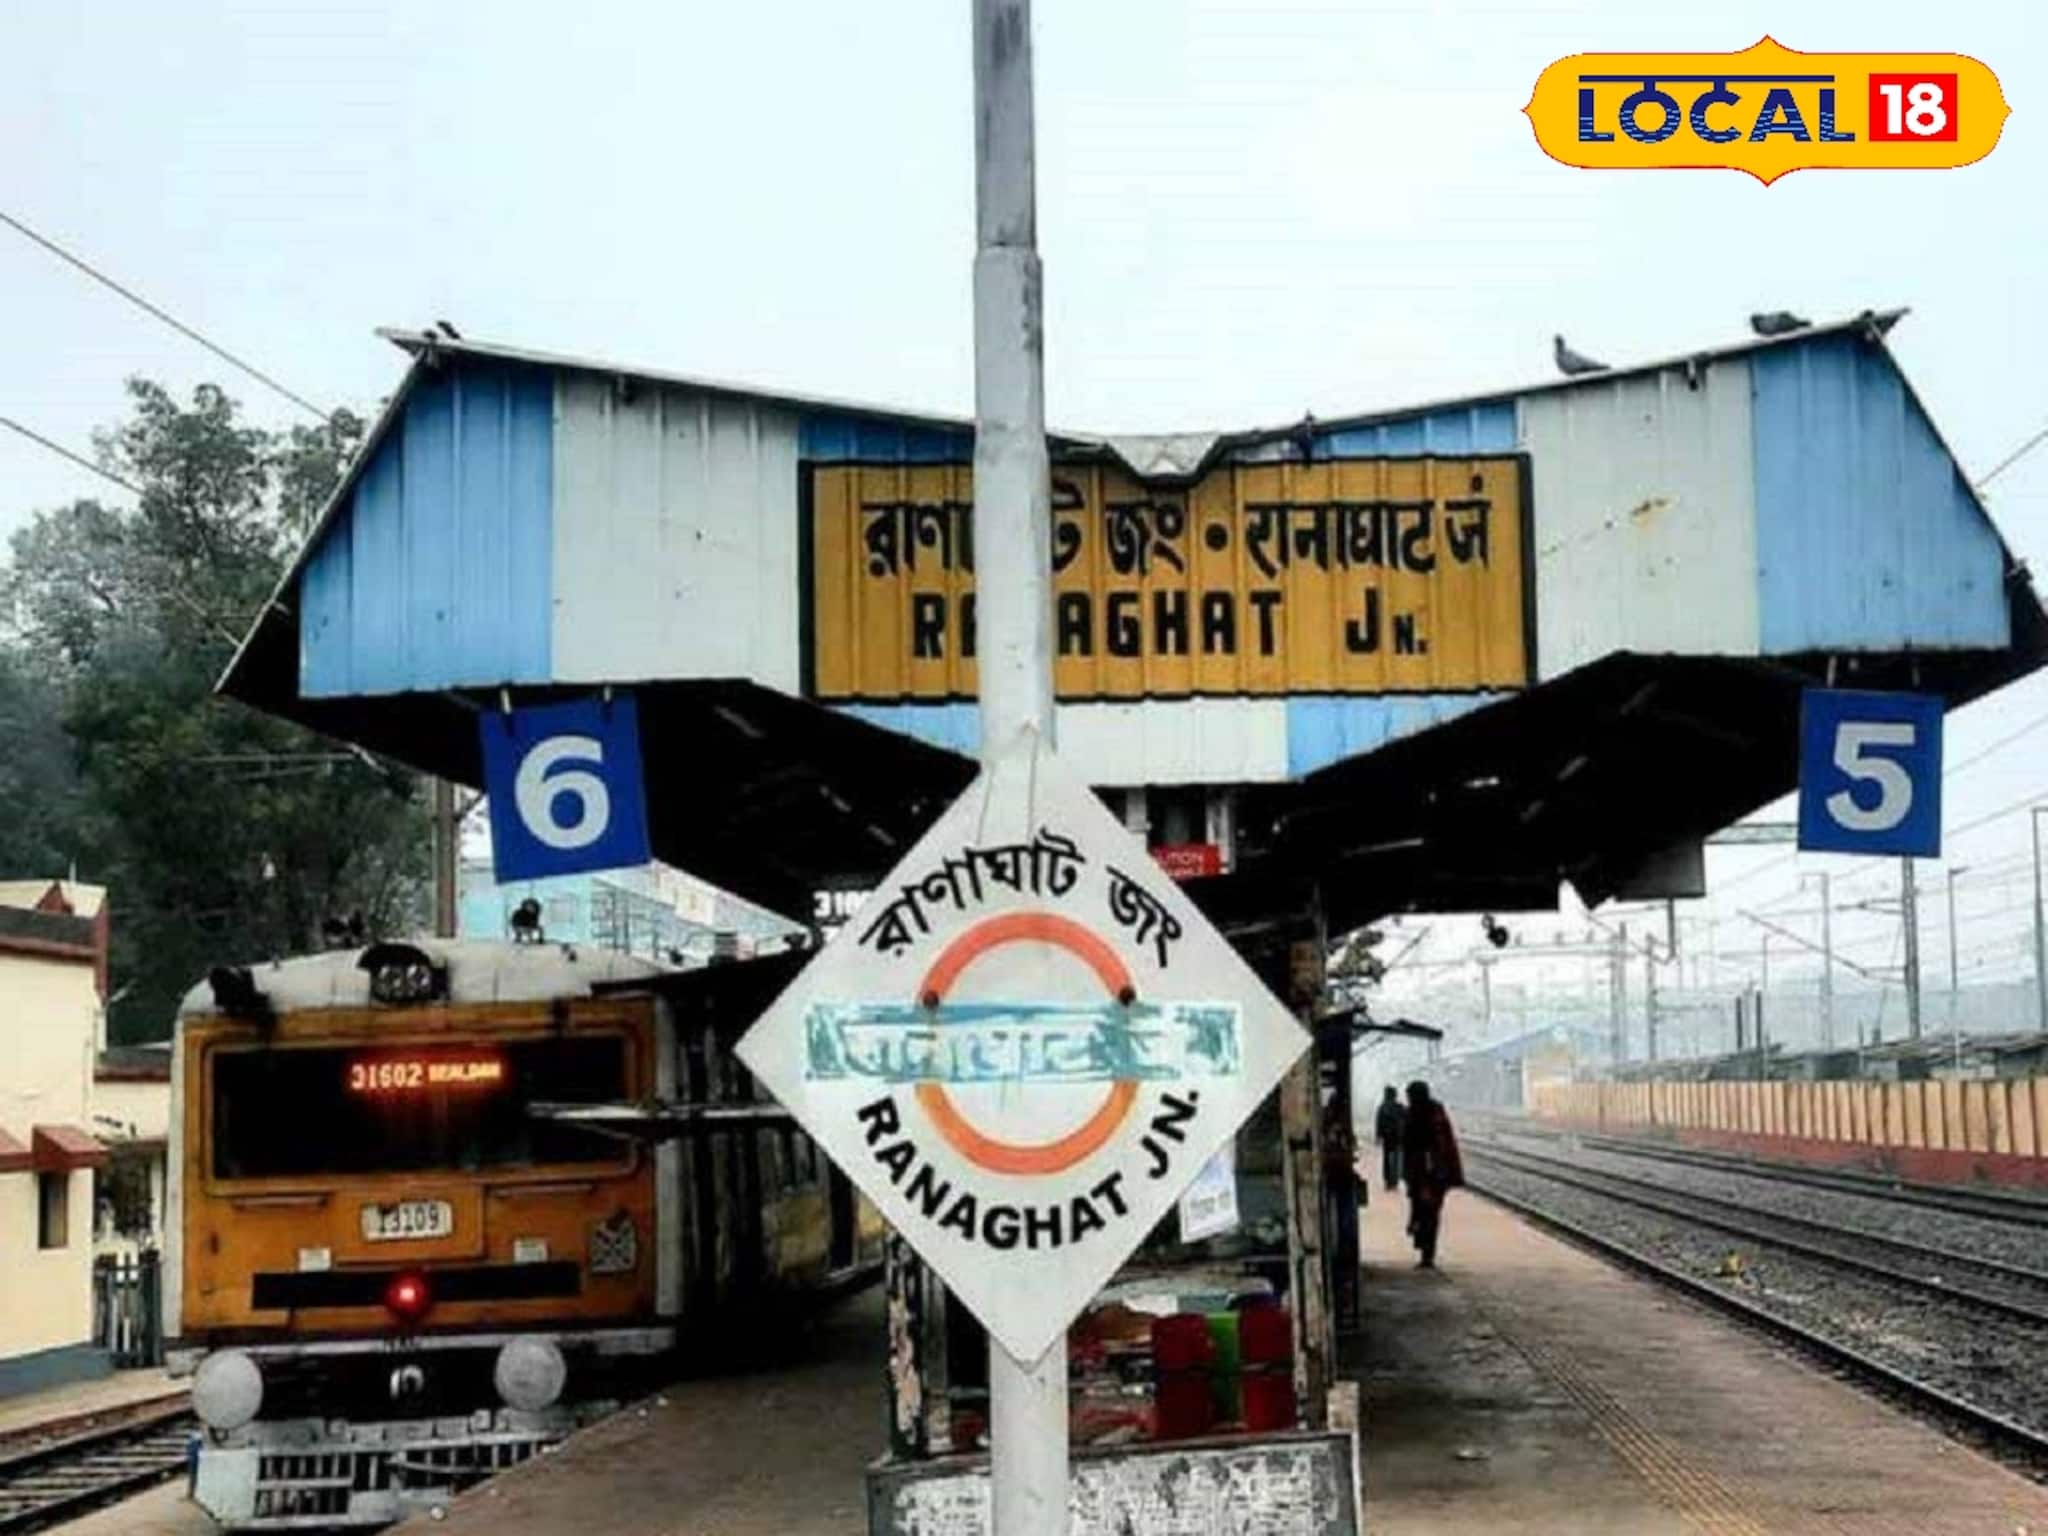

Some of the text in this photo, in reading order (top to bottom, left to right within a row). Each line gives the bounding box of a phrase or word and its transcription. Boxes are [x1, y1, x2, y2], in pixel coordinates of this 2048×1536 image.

[912, 589, 1283, 658] RAGHAT
[515, 734, 610, 849] 6
[1826, 720, 1916, 831] 5
[859, 827, 1184, 969] রাণাঘাট জং
[857, 1091, 1200, 1250] RANAGHAT JN.
